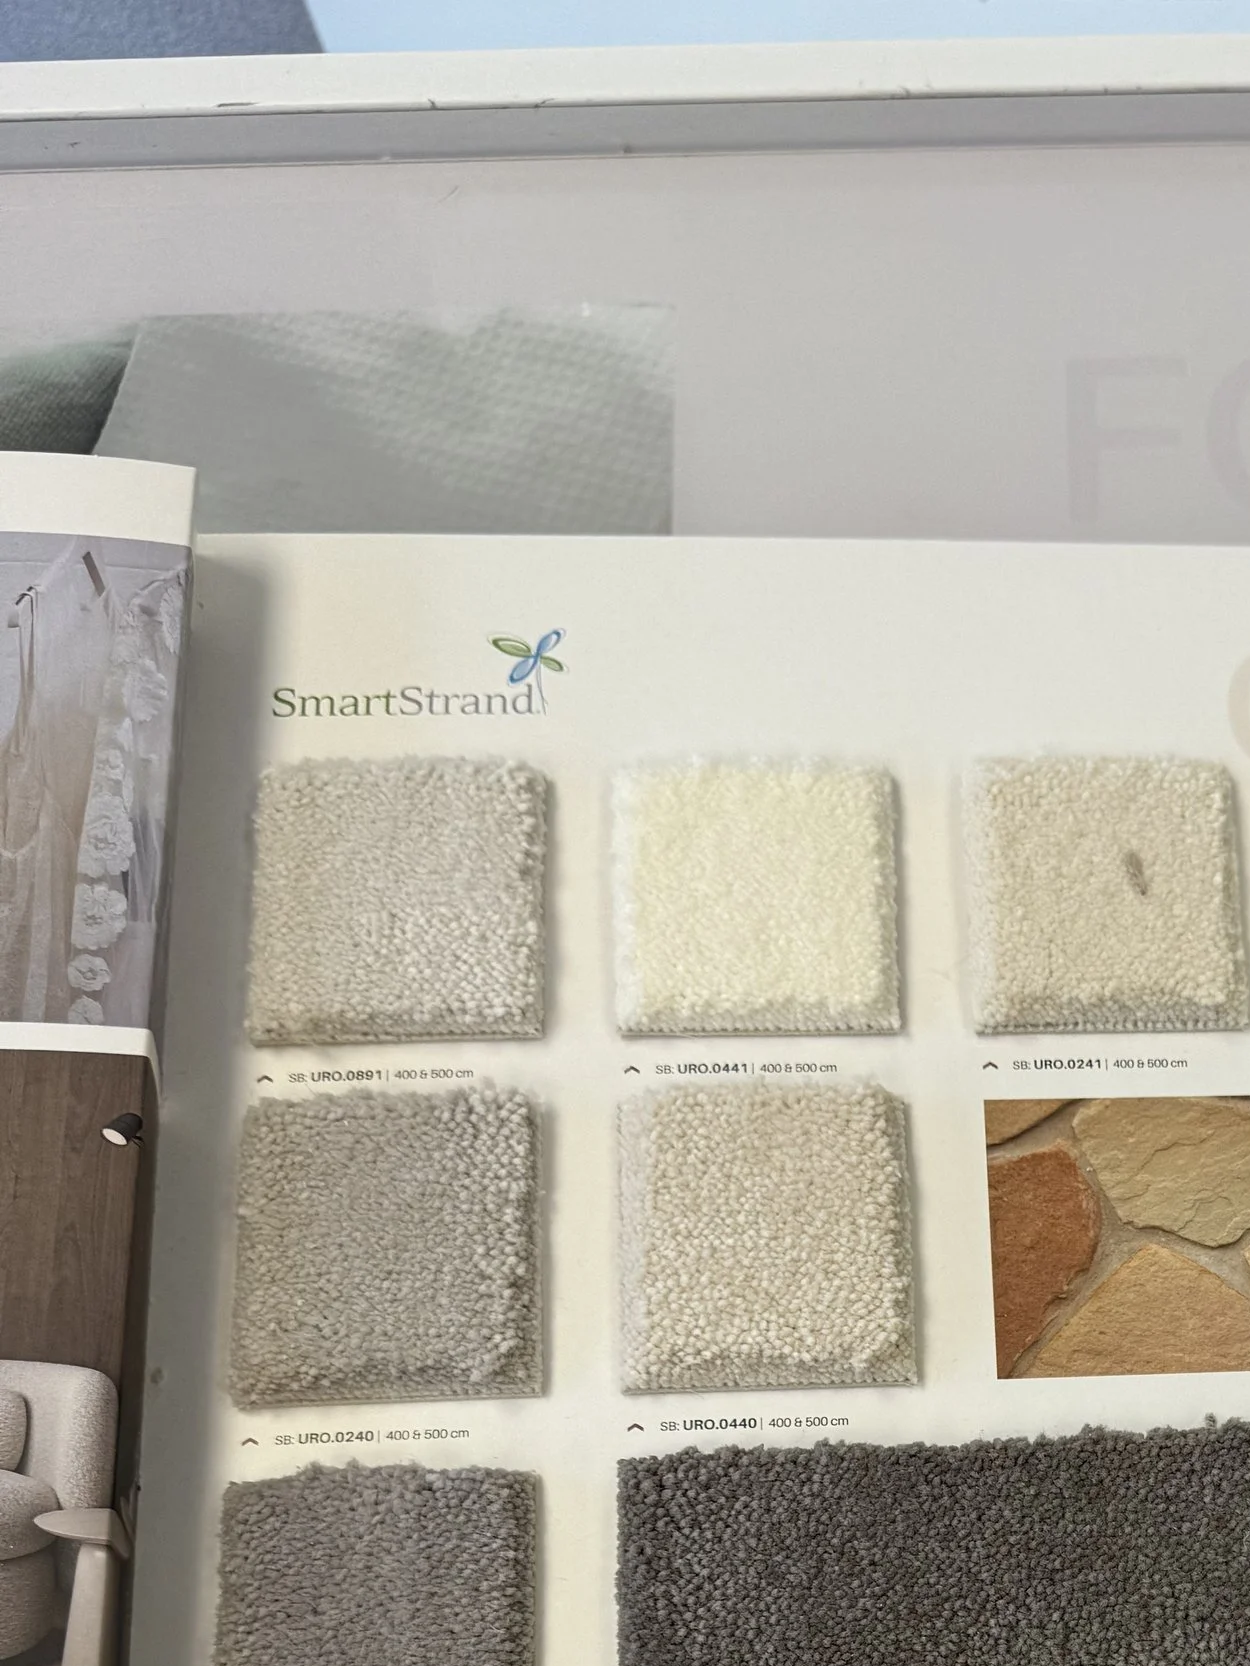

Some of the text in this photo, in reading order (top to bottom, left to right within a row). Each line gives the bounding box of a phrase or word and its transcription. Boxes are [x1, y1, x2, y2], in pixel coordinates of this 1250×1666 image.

[272, 684, 536, 717] SmartStrand
[655, 1063, 748, 1074] SB: URO.0441
[1012, 1058, 1102, 1070] SB: URO.0241
[288, 1069, 382, 1083] SB: URO.0891
[660, 1416, 849, 1431] SB: URO.0440 400 & 500 cm
[274, 1430, 374, 1446] SB: URO.0240
